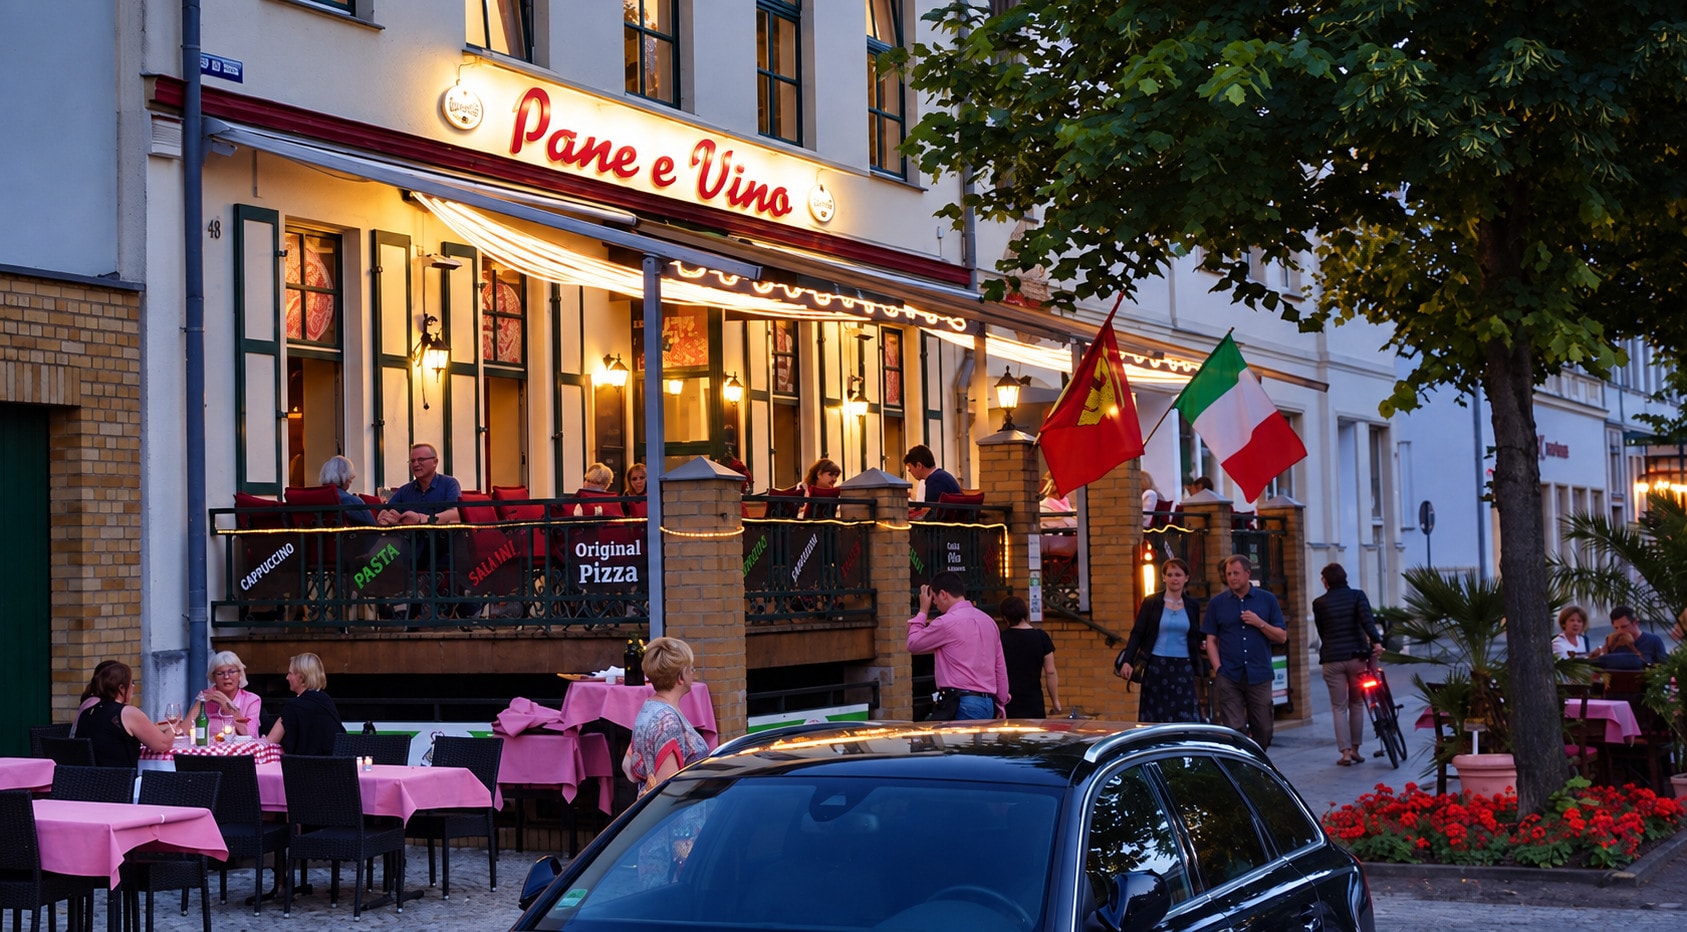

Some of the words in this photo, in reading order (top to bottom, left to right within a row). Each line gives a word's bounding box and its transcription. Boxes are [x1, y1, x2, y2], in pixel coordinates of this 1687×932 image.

[511, 87, 640, 178] Pane
[652, 156, 677, 188] e
[691, 138, 793, 218] Vino
[207, 219, 221, 239] 48
[240, 542, 295, 591] CAPPUCCINO
[353, 543, 401, 590] PASTA
[575, 539, 642, 561] Original
[578, 561, 639, 584] Pizza
